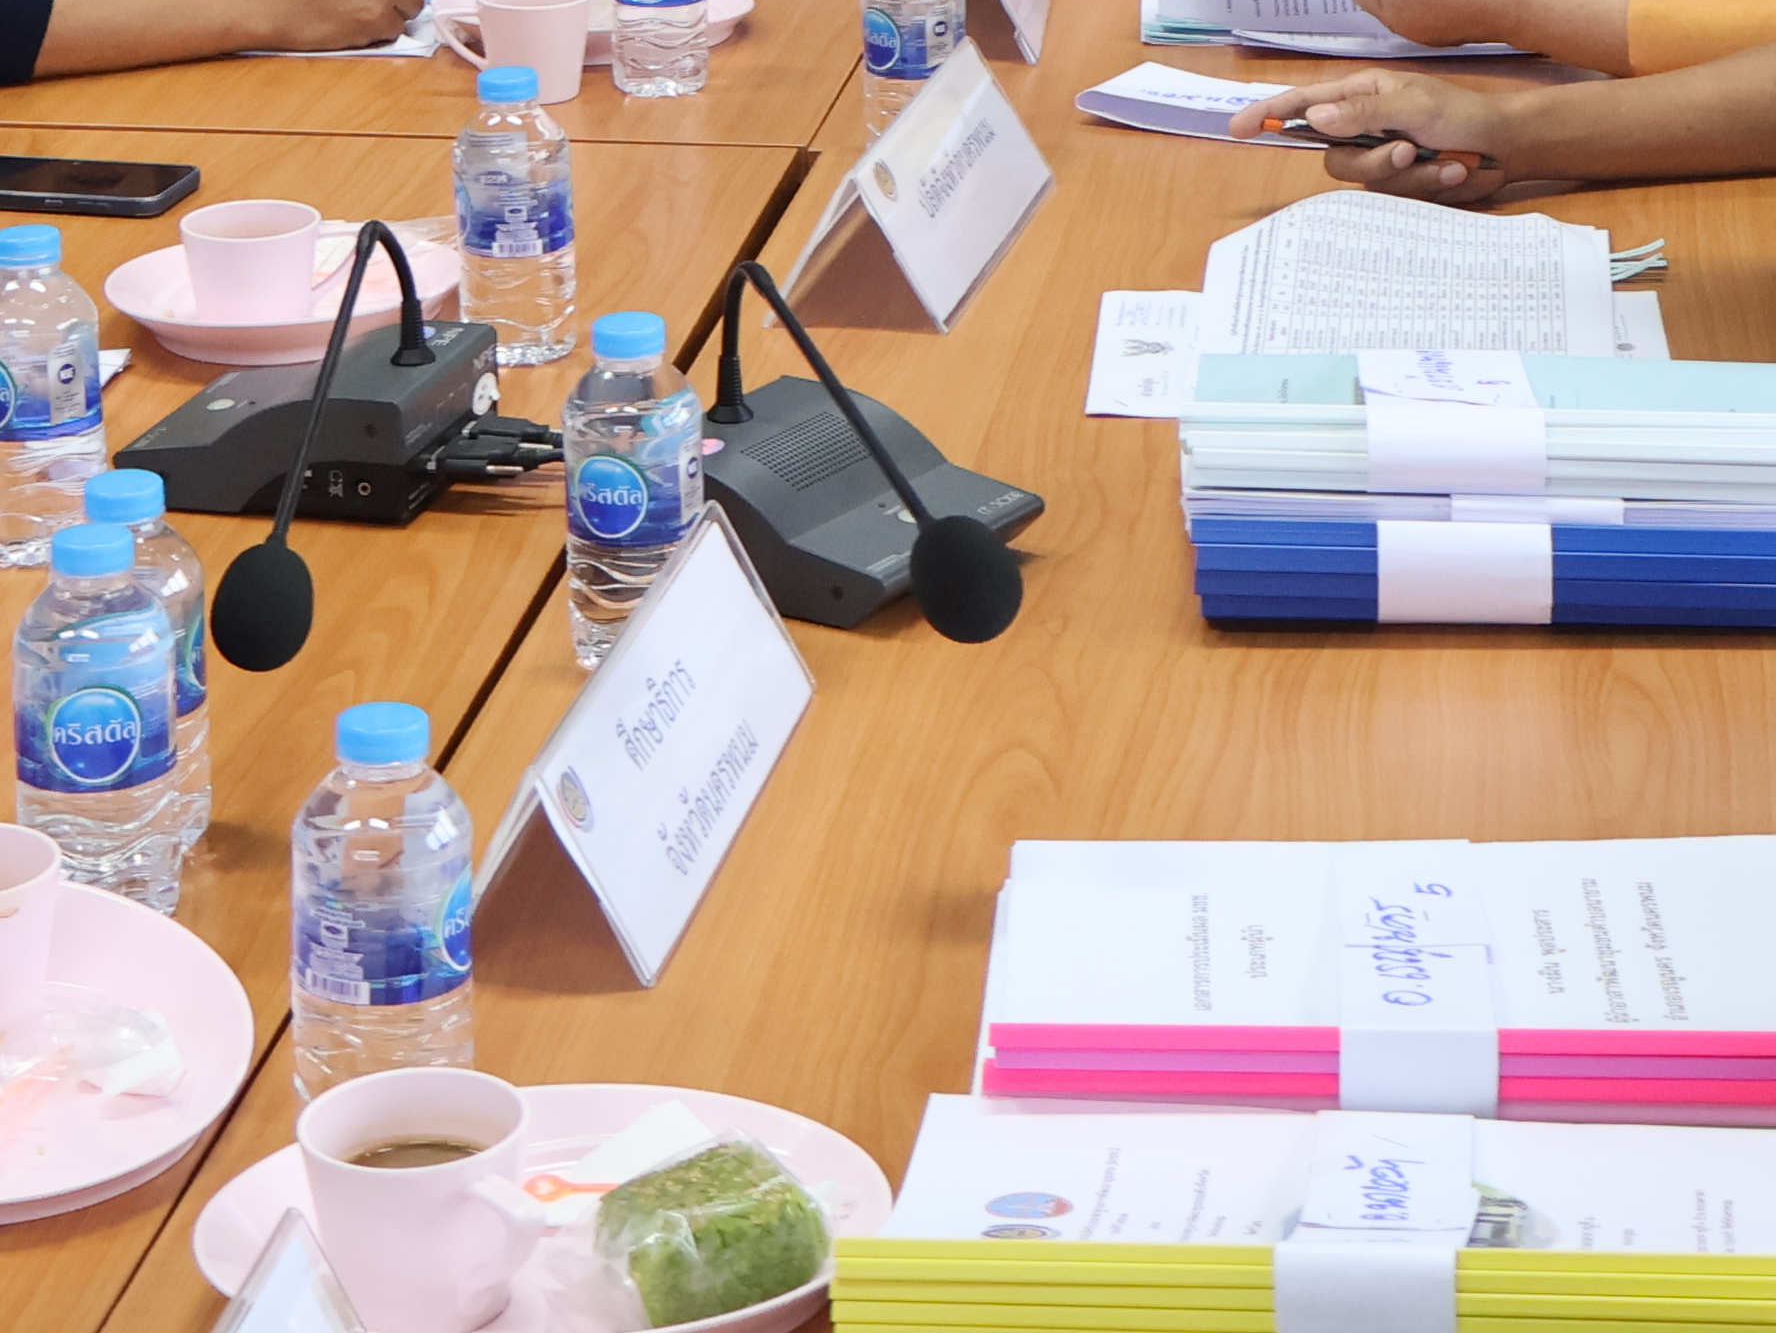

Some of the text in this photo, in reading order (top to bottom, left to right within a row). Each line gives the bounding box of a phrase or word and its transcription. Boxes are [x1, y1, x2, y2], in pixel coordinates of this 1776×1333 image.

[616, 659, 697, 771] ศึกษาธิการ
[659, 718, 760, 877] จังหวัดนครพนม
[1636, 881, 1669, 952] จังหวัดนครพนม
